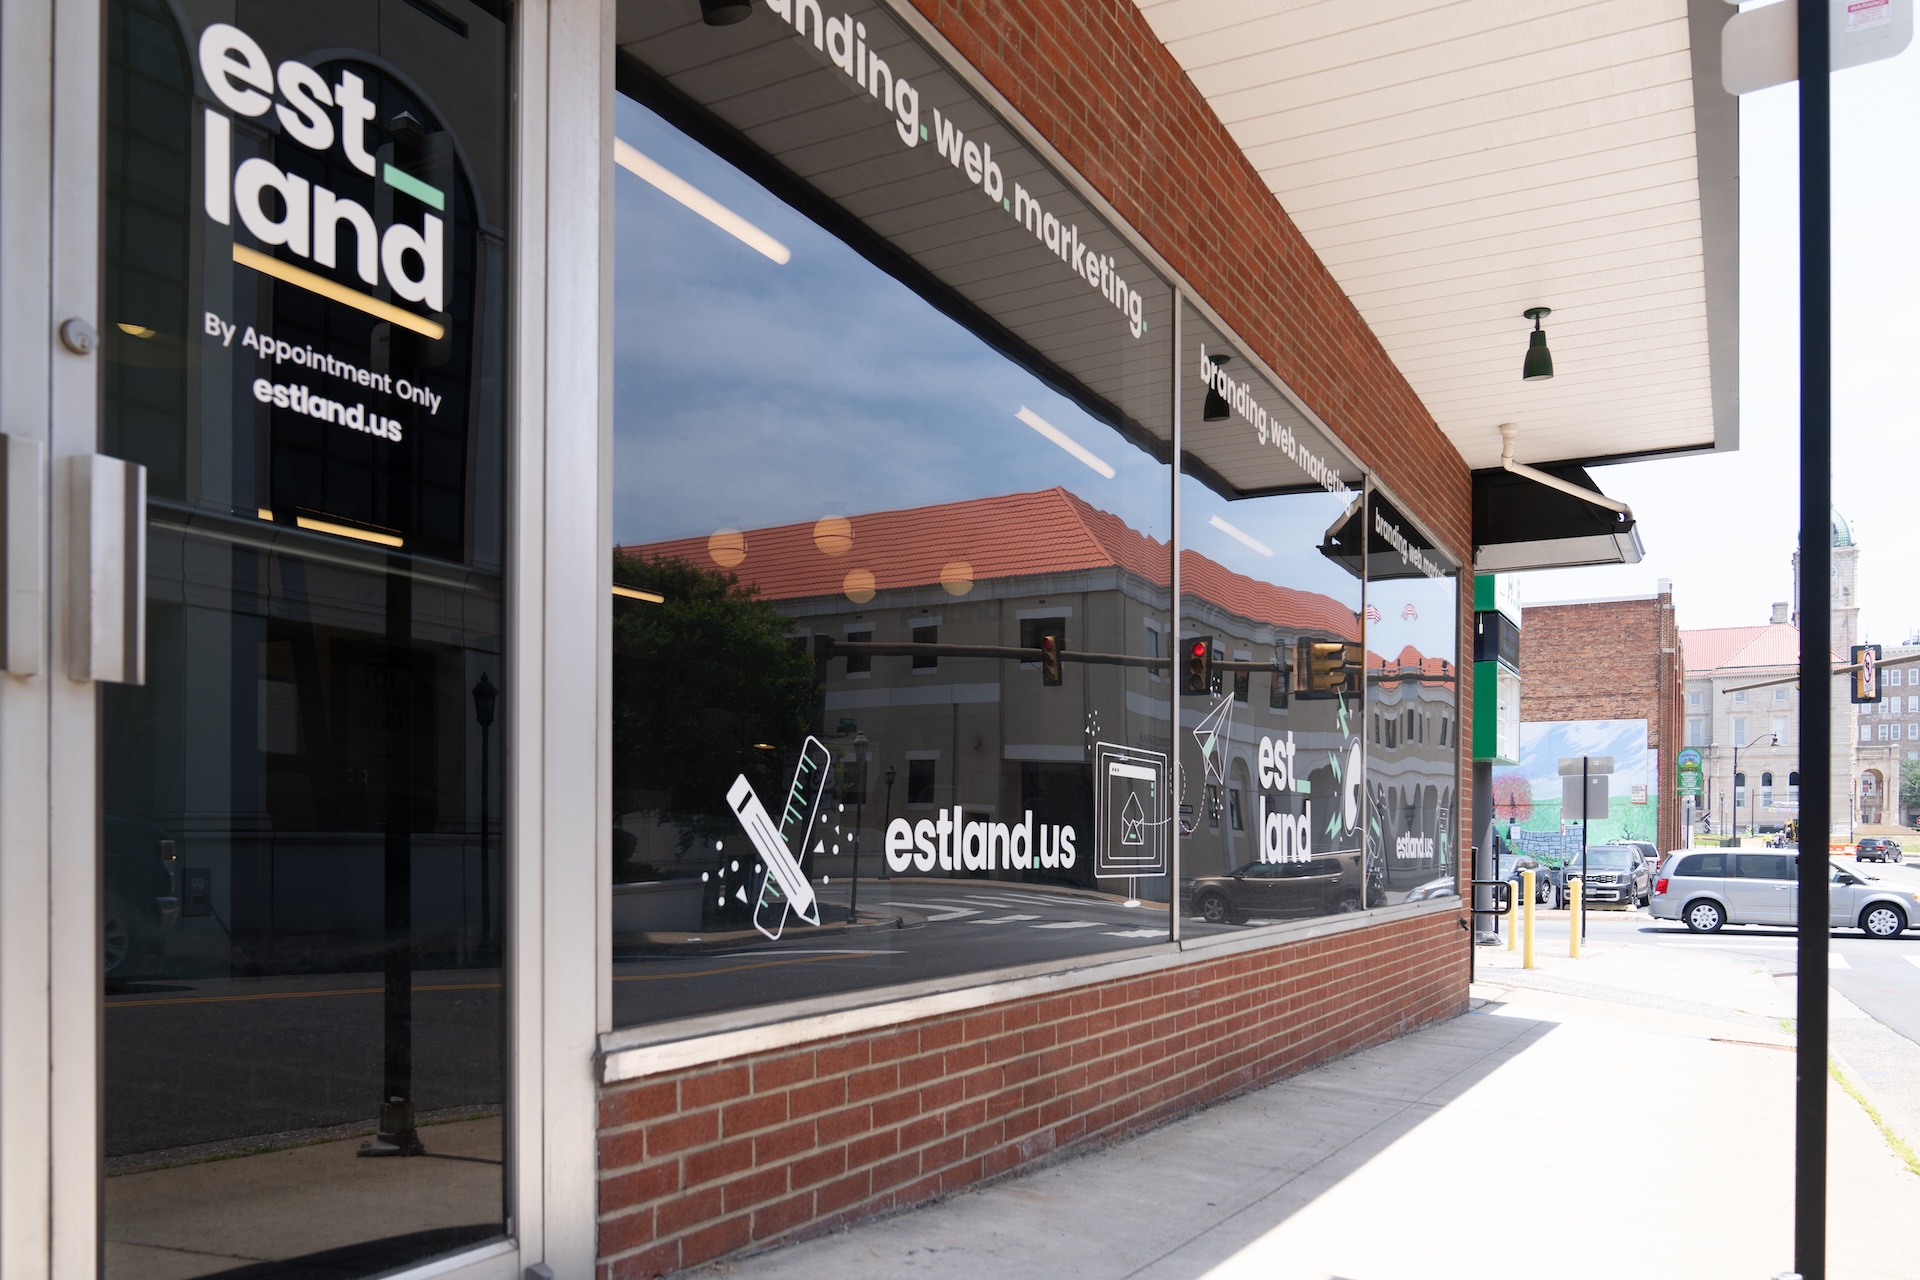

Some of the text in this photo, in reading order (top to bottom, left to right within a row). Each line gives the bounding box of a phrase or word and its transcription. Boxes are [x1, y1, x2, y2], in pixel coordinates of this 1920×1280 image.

[204, 108, 444, 312] land
[205, 312, 442, 415] By Appointment Only
[253, 377, 402, 442] estland.us
[885, 805, 1076, 871] estland.us
[1260, 795, 1311, 864] land
[1396, 830, 1434, 860] estland.us
